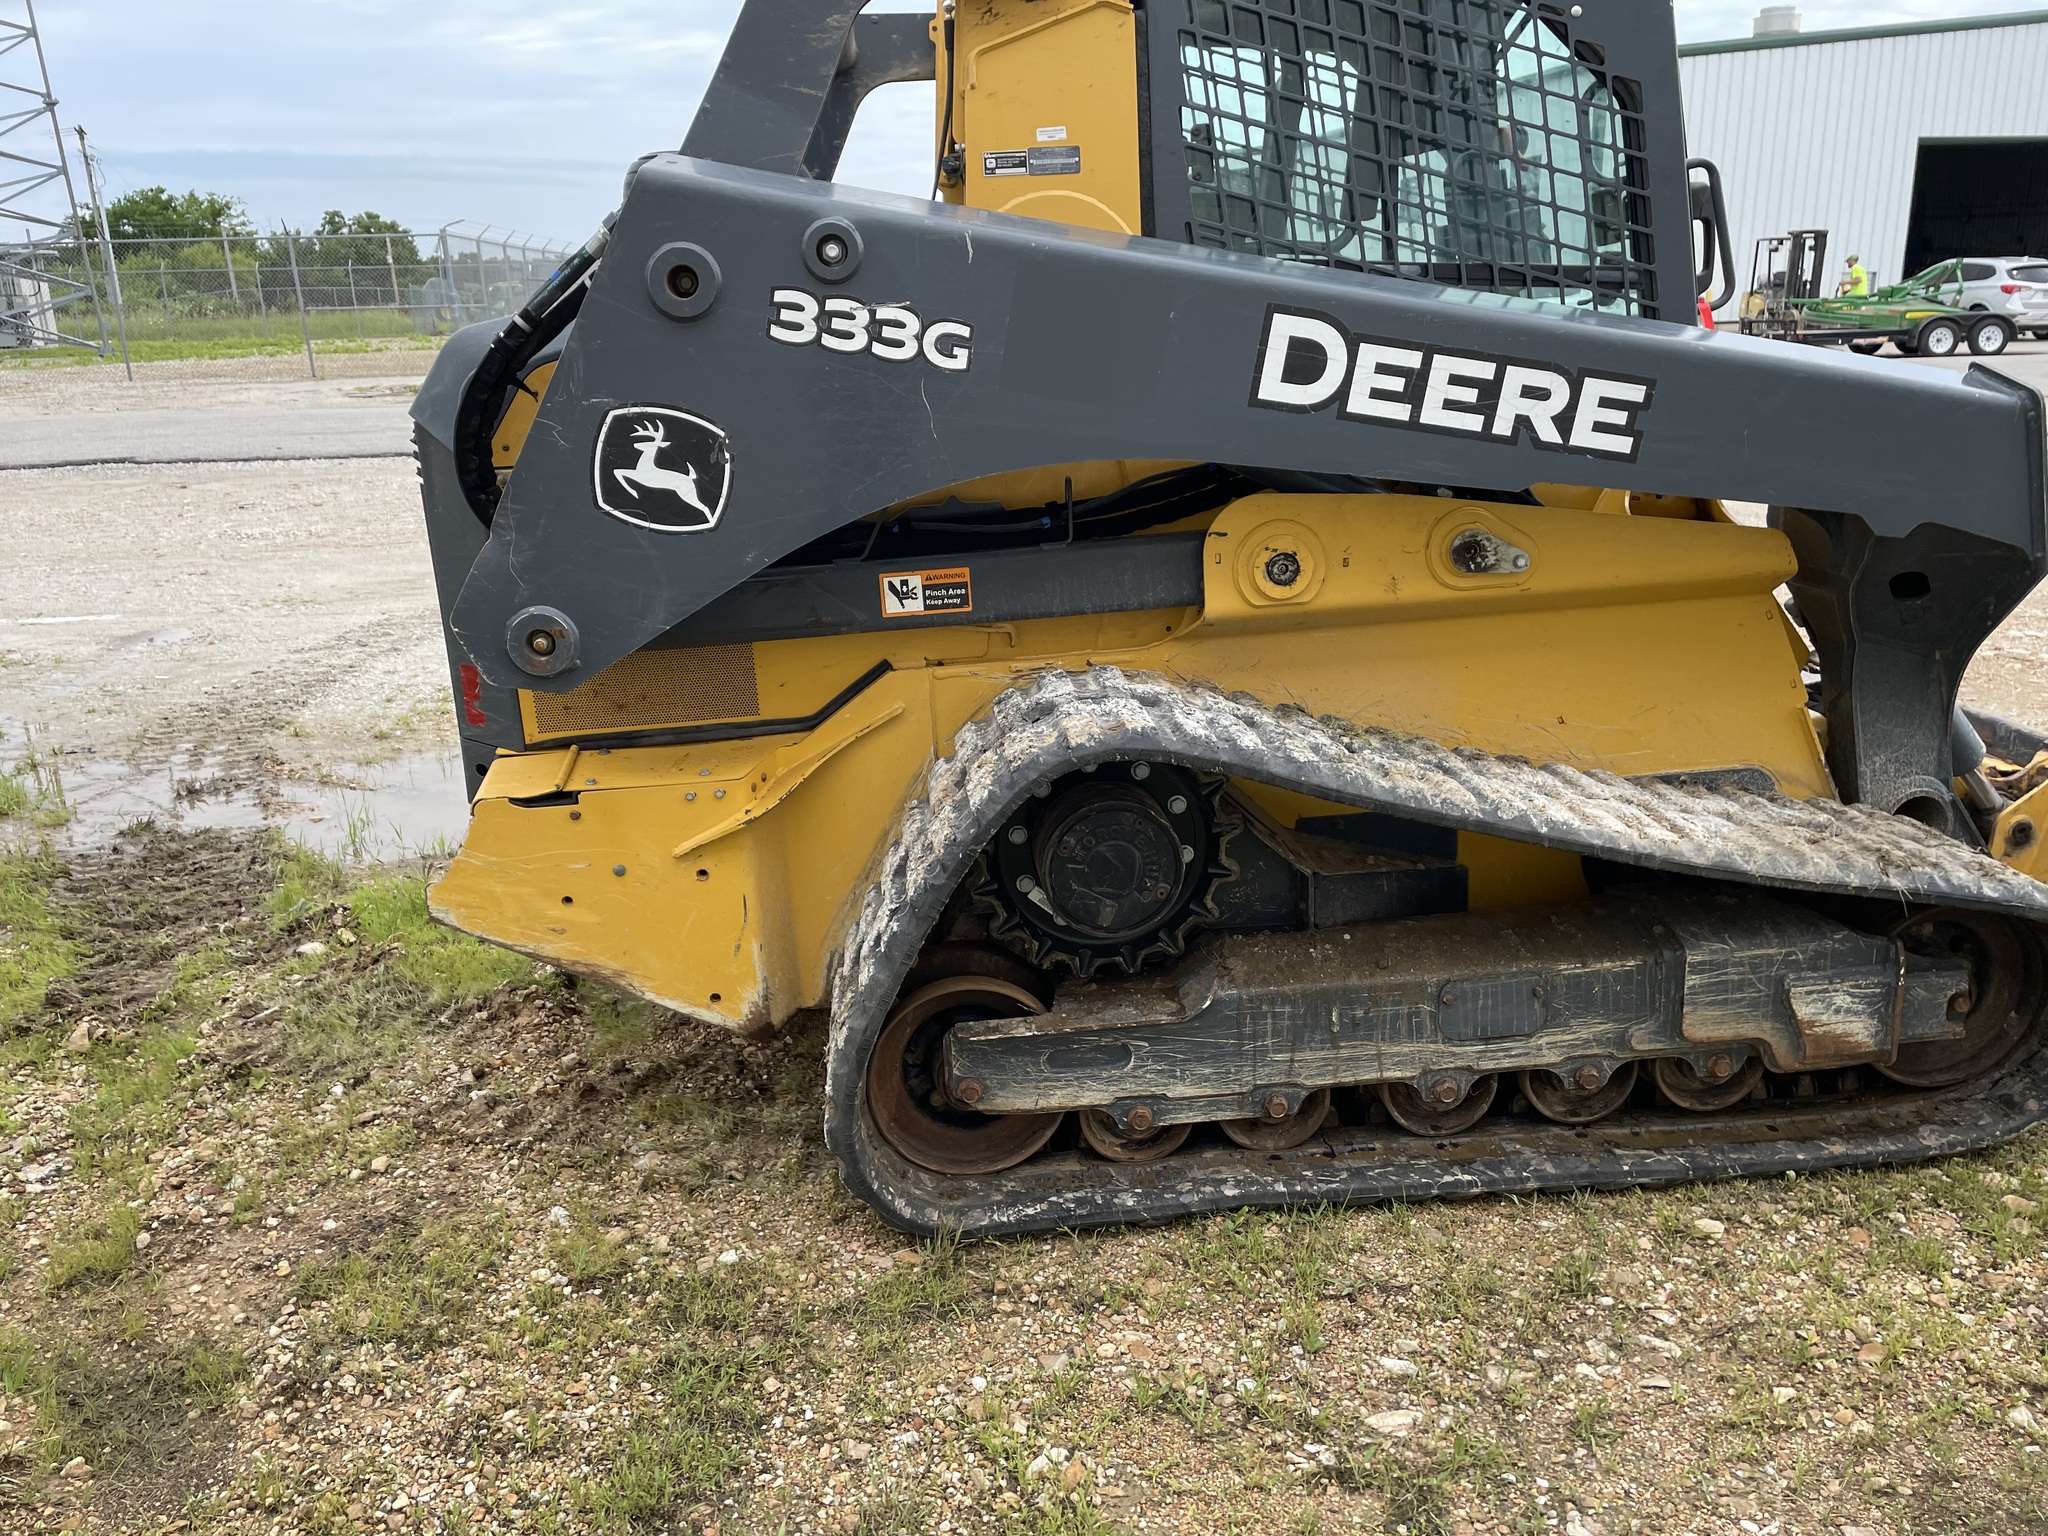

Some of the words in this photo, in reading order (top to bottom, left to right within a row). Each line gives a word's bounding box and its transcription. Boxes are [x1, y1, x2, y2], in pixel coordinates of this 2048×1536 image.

[769, 289, 971, 370] 333G
[1258, 312, 1647, 454] DEERE
[925, 588, 947, 596] Pinch
[932, 572, 966, 580] WARNING
